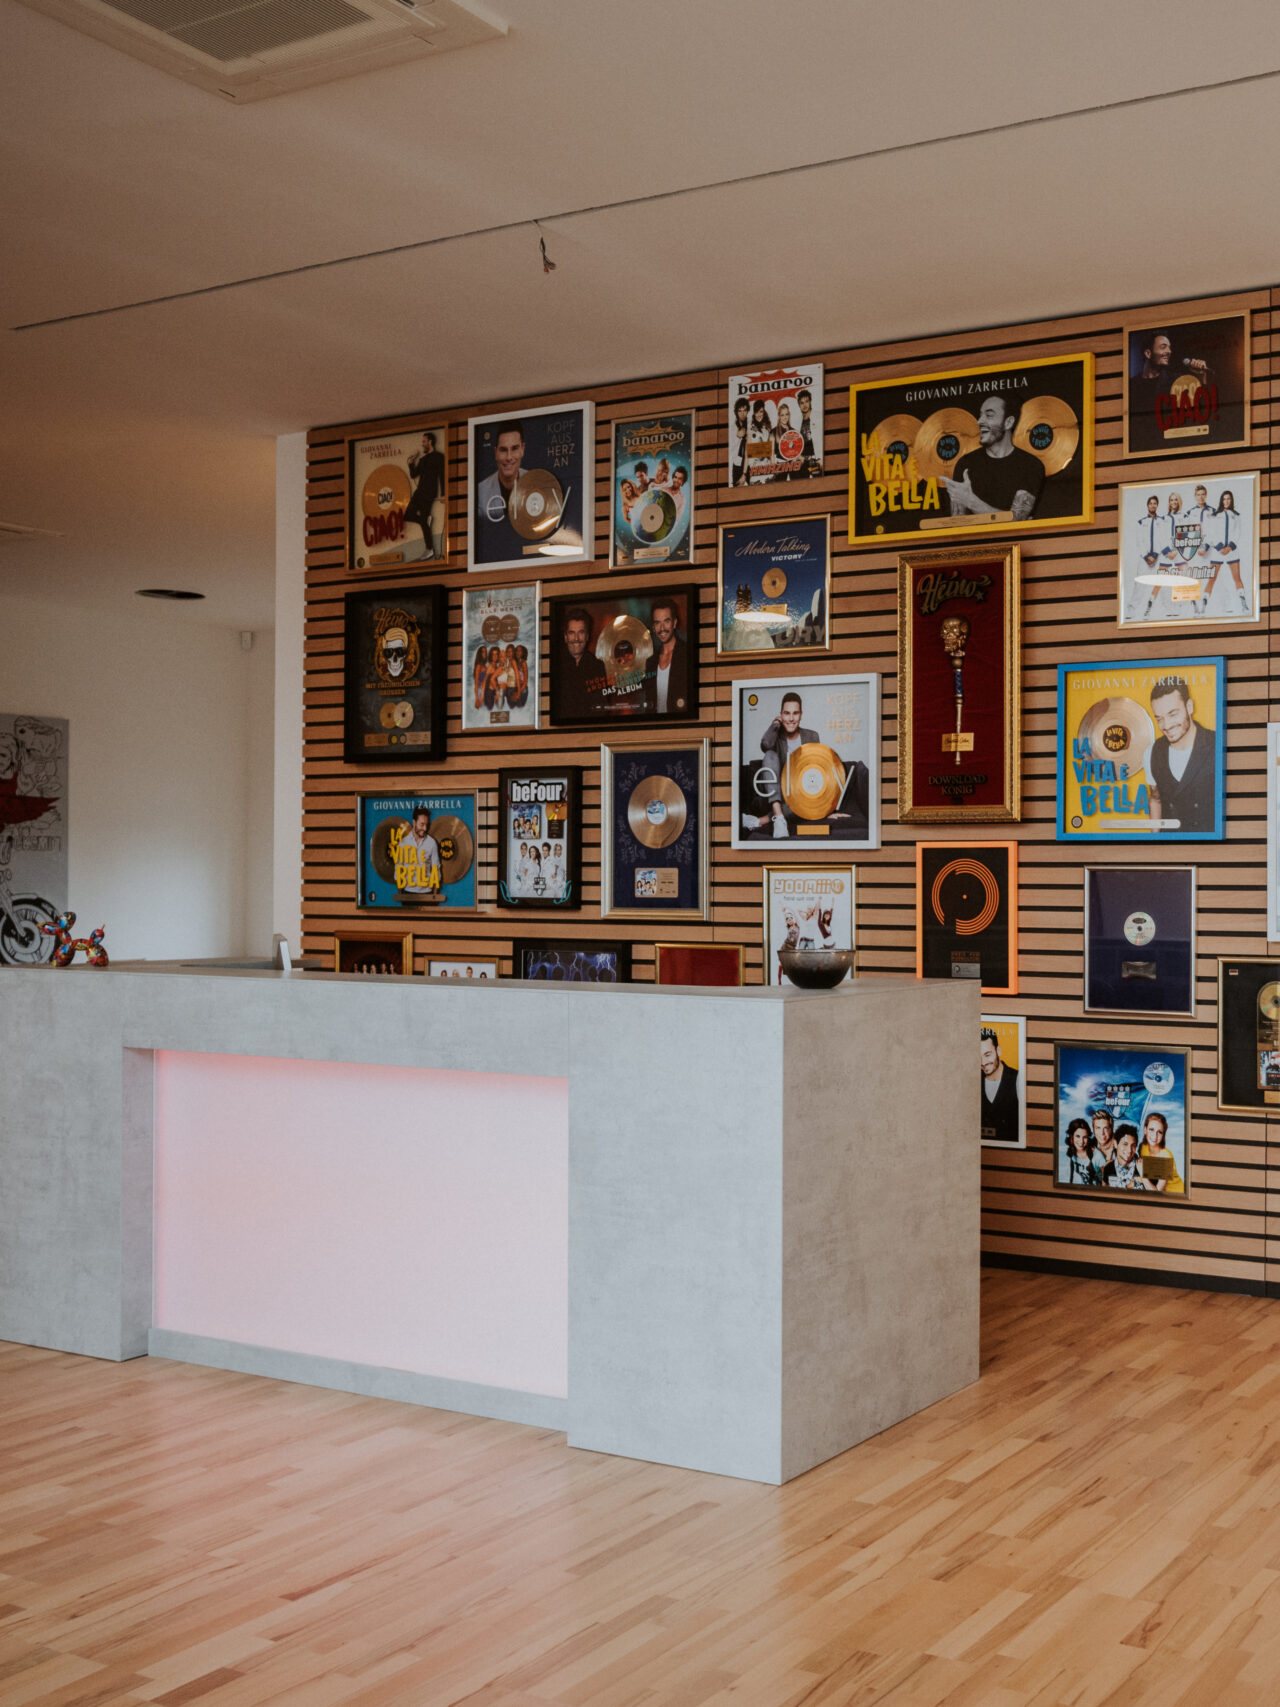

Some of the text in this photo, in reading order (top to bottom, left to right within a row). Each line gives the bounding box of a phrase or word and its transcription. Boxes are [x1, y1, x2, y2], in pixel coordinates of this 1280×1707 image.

[738, 376, 814, 396] banaroo
[905, 376, 1029, 402] GIOVANNI ZARRELLA
[1154, 383, 1220, 431] CIAO!
[547, 419, 576, 433] KOPF
[551, 431, 573, 444] AUS
[622, 430, 685, 447] banaroo
[861, 430, 880, 456] LA
[547, 443, 576, 457] HERZ
[553, 456, 569, 468] AN
[750, 460, 802, 477] AMAZING
[861, 452, 905, 482] VITA
[868, 477, 941, 517] BELLA
[362, 507, 406, 548] CIAO!
[735, 535, 811, 557] Modern Talking
[771, 554, 803, 562] VICTORY
[602, 682, 643, 696] DAS ALBUM
[1073, 674, 1208, 690] GIOVANNI ZARRELLA
[826, 692, 861, 705] KOPF
[826, 718, 860, 731] HERZ
[834, 732, 853, 743] AN
[1073, 737, 1092, 760] LA
[1072, 759, 1115, 784] VITA
[928, 775, 986, 786] DOWNLOAD
[512, 781, 563, 802] beFour
[941, 784, 974, 796] KÖNIG
[373, 799, 461, 810] GIOVANNI ZARRELLA
[1080, 784, 1150, 817] BELLA
[390, 828, 403, 845] LA
[390, 845, 418, 864] VITA
[395, 863, 440, 889] BELLA
[1105, 1097, 1131, 1106] beFour
